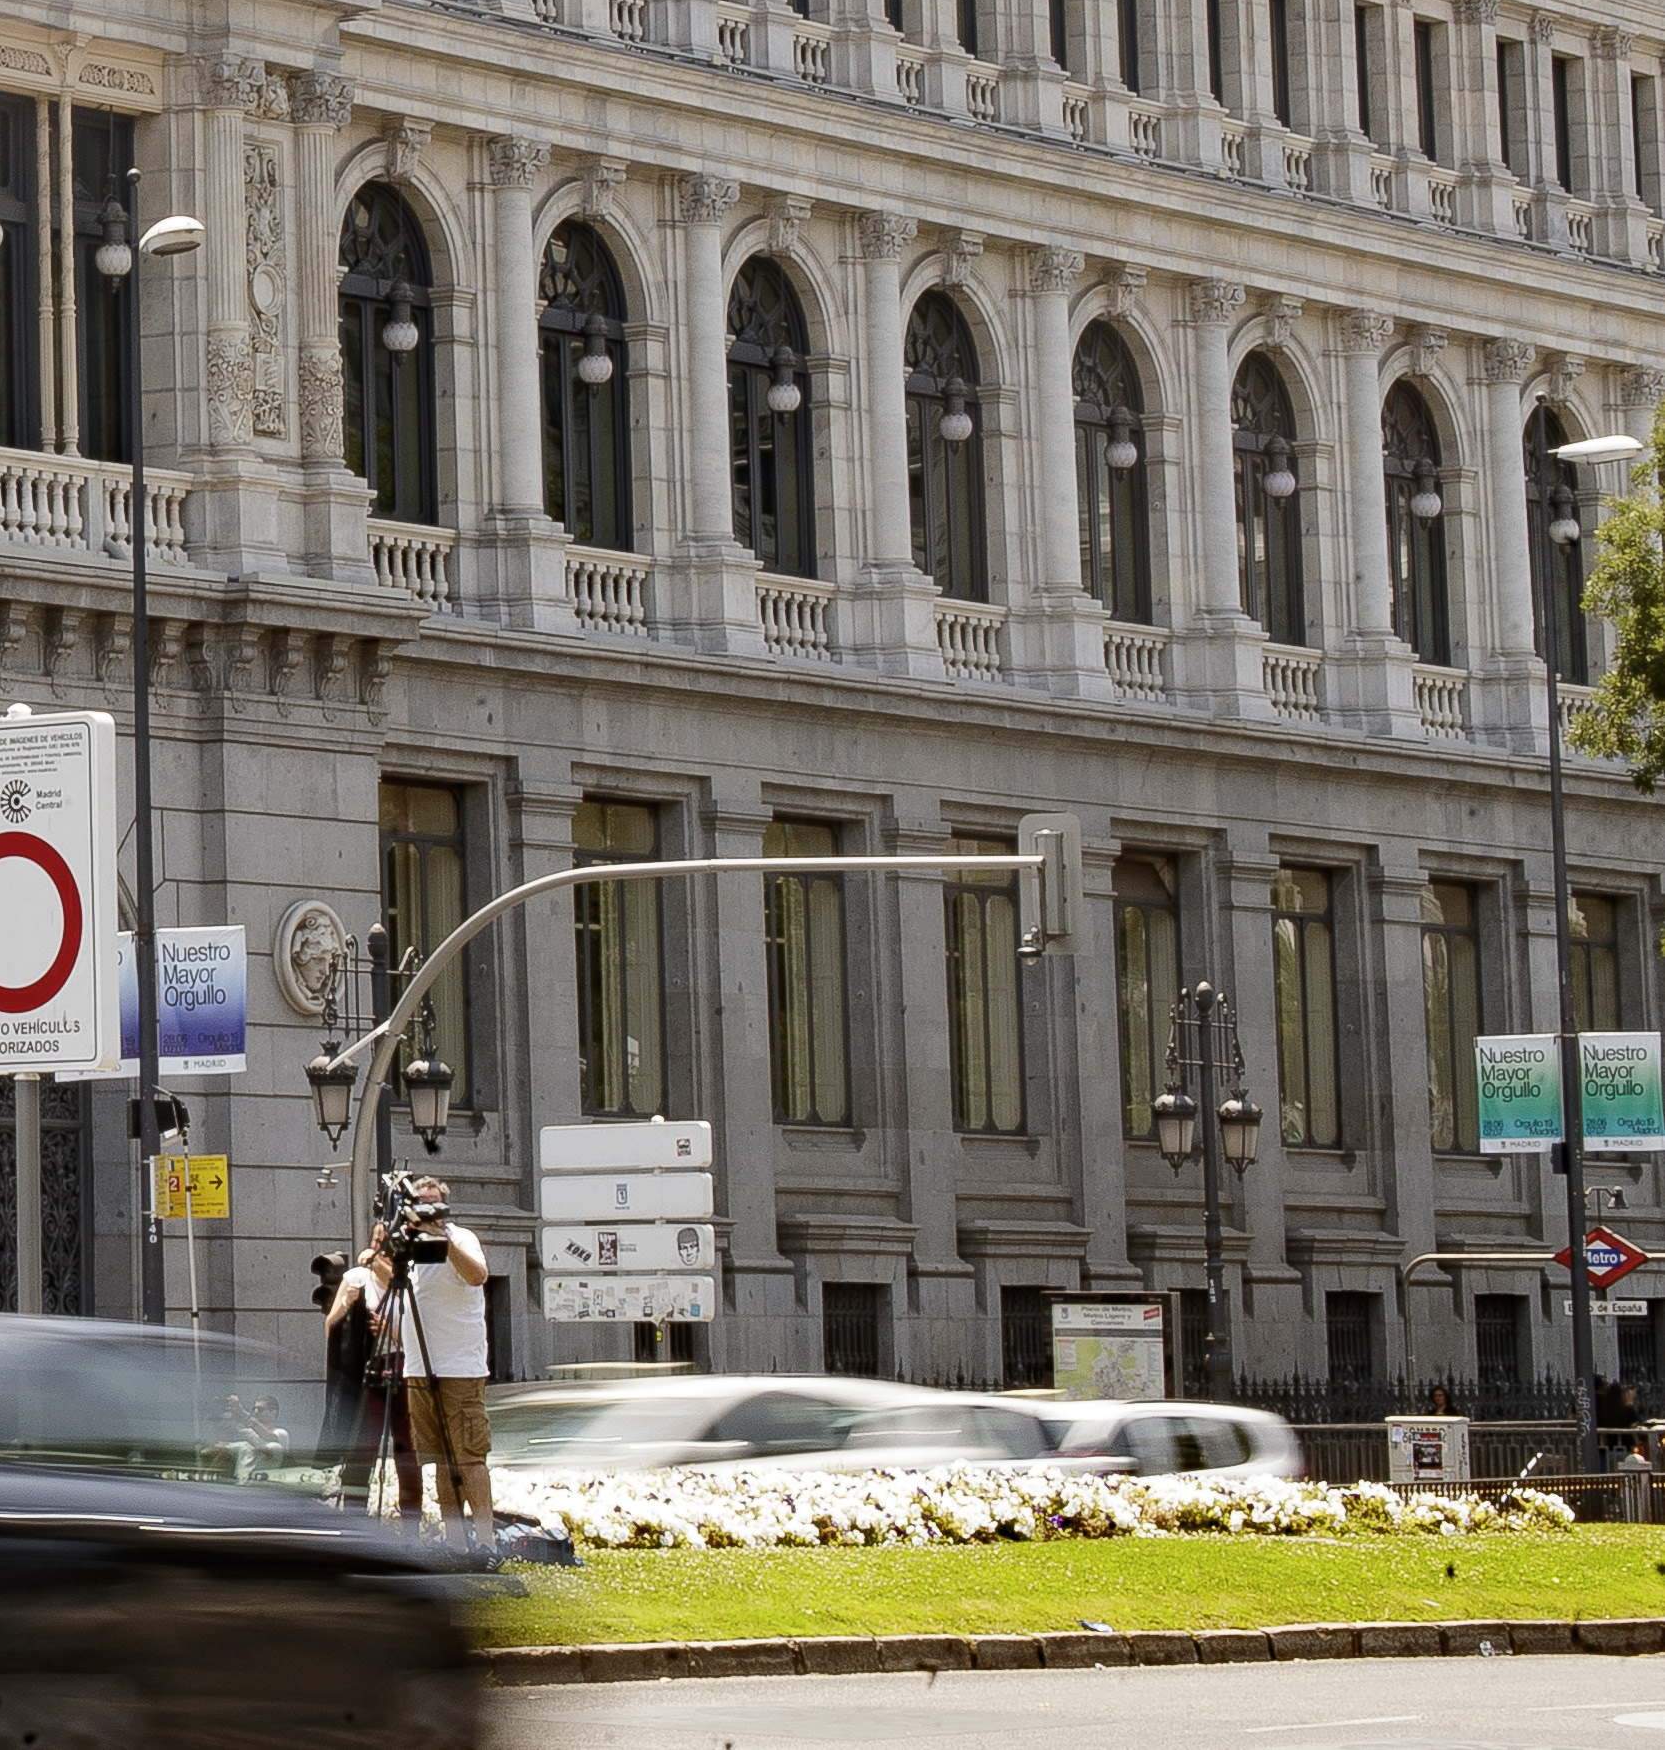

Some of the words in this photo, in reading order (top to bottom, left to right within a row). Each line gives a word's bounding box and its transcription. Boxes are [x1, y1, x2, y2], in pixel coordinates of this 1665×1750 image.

[36, 790, 62, 798] Madrid
[36, 801, 62, 810] Central
[162, 942, 230, 963] Nuestro
[163, 965, 216, 989] Mayor
[164, 985, 226, 1011] Orgullo
[1480, 1048, 1544, 1063] Nuestro
[1583, 1045, 1647, 1061] Nuestro
[1481, 1065, 1532, 1084] Mayor
[1584, 1063, 1634, 1082] Mayor
[1482, 1082, 1541, 1102] Orgullo
[1585, 1080, 1644, 1100] Orgullo
[170, 1177, 178, 1191] 2
[1597, 1303, 1608, 1313] de
[1612, 1303, 1642, 1313] España
